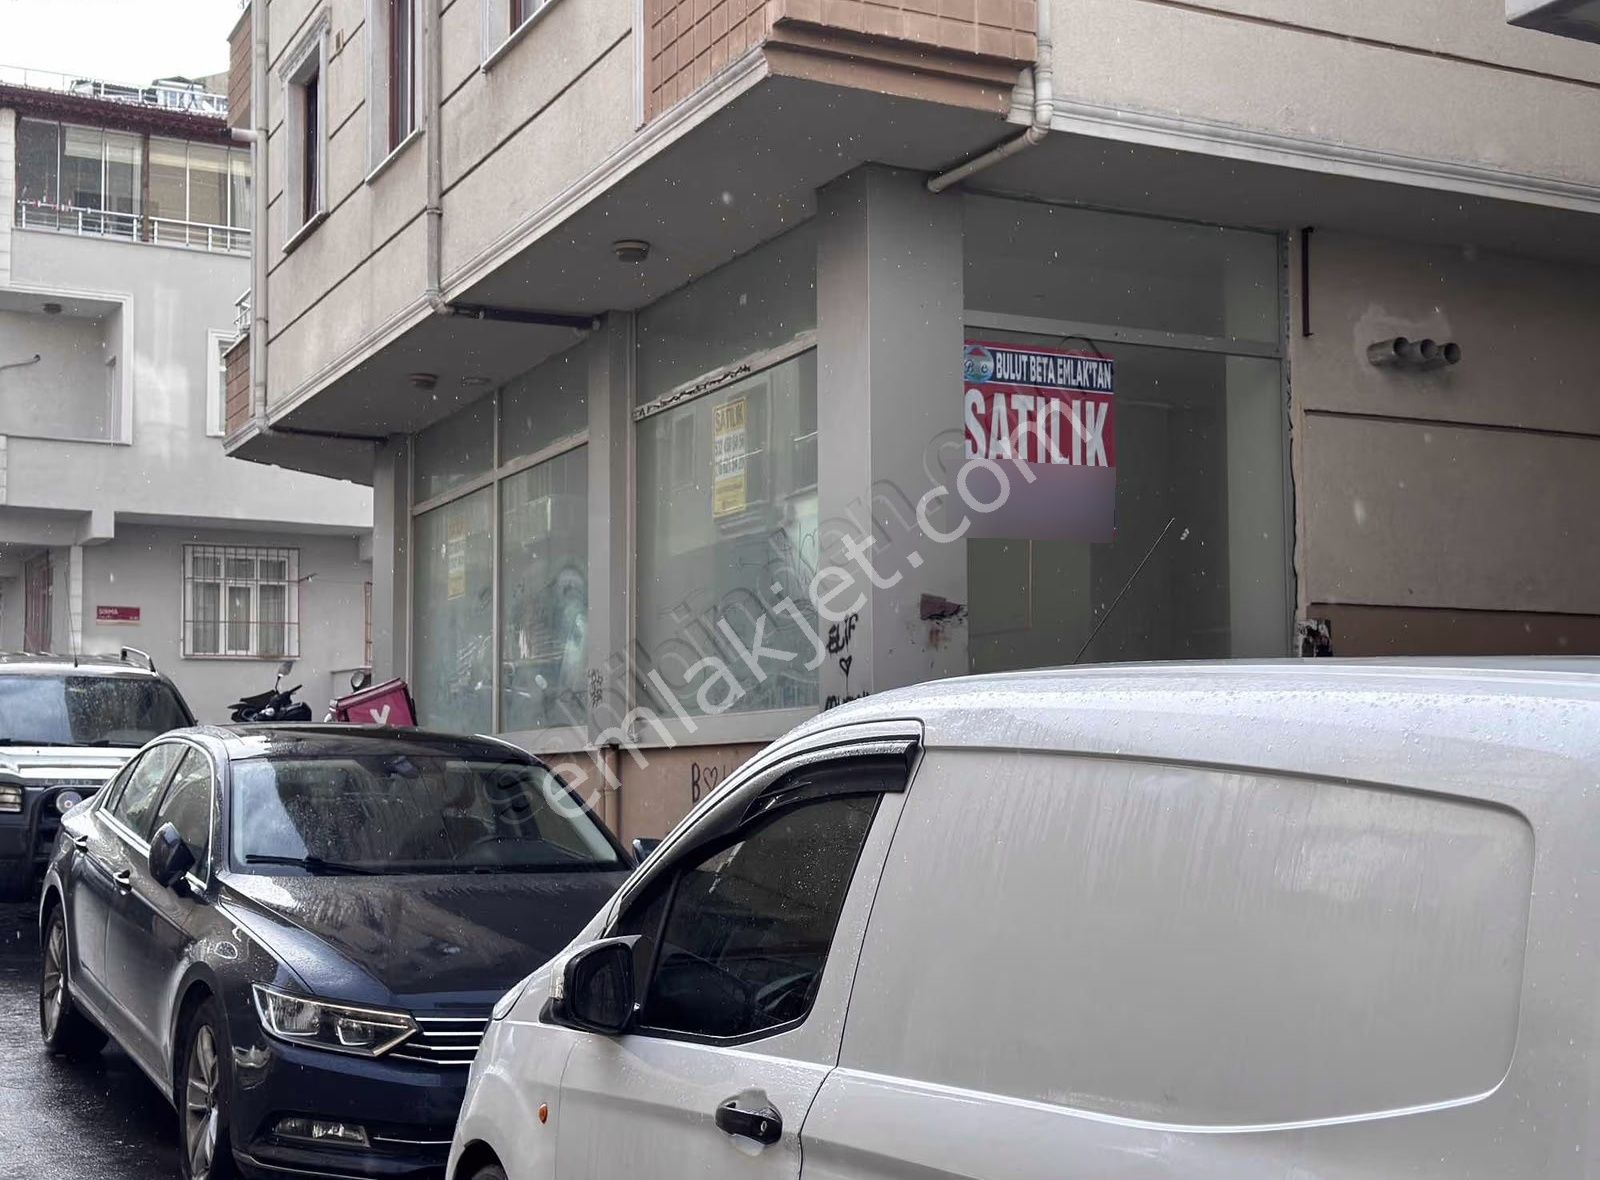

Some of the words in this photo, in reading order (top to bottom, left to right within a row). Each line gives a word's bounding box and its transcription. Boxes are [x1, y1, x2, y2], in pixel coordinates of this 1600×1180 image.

[996, 352, 1028, 381] BULUT
[1030, 356, 1056, 384] BETA
[1057, 359, 1112, 389] EMLAK'TAN
[965, 388, 1109, 467] SATILIK
